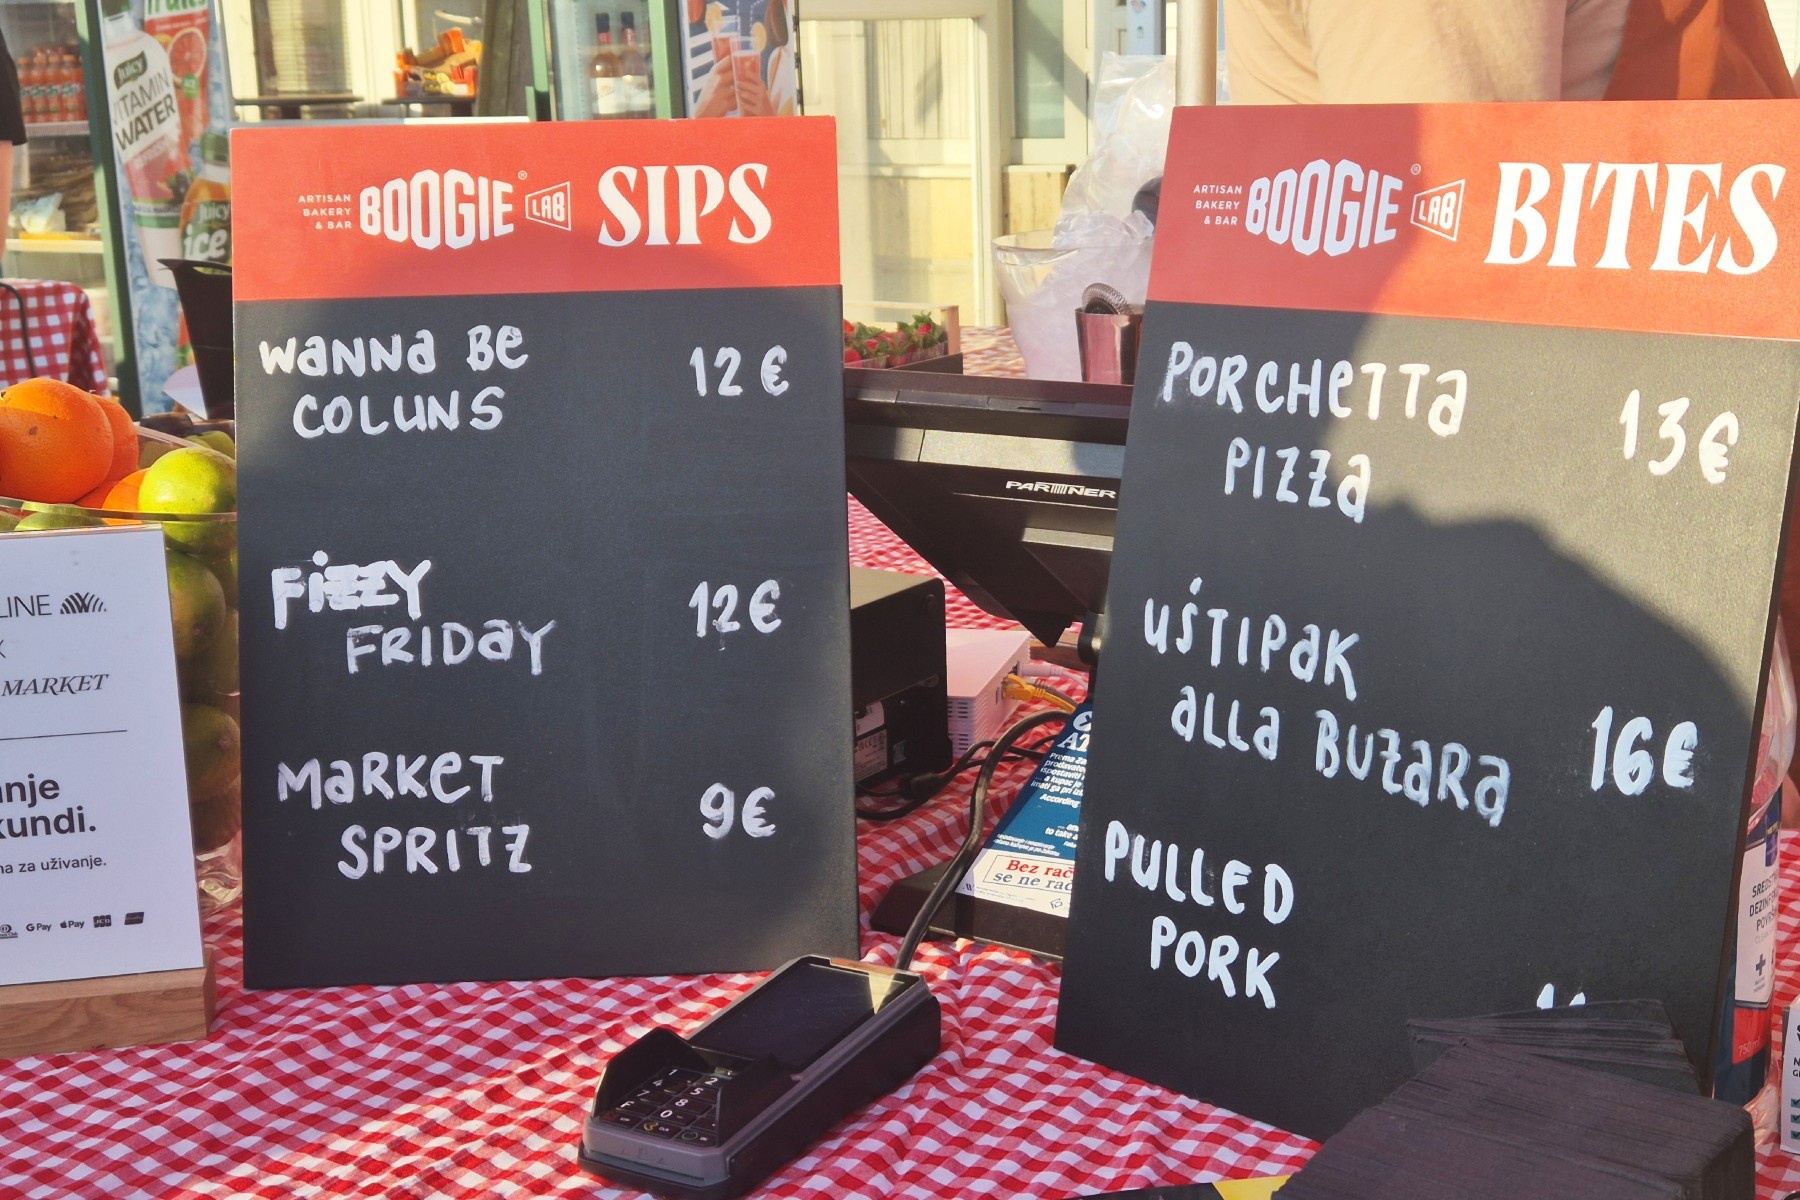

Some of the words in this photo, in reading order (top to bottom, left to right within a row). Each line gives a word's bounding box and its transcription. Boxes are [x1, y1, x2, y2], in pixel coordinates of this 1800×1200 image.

[115, 93, 176, 150] WATER
[1193, 184, 1243, 195] ARTISAN
[298, 194, 351, 203] ARTISAN
[597, 163, 772, 247] SIPS
[1195, 199, 1240, 210] BAKERY
[303, 207, 351, 217] BAKERY
[360, 169, 514, 250] BOOGIE
[532, 191, 566, 223] LAB
[1245, 159, 1403, 257] BOOGIE
[1418, 191, 1457, 230] LAB
[315, 221, 323, 230] &
[327, 221, 351, 229] BAR
[1203, 215, 1211, 225] &
[1208, 216, 1239, 225] BAR
[1483, 161, 1787, 276] BITES
[184, 223, 228, 261] ice
[1, 673, 110, 697] MARKET
[0, 773, 60, 808] nje
[1040, 793, 1081, 809] According
[337, 824, 532, 880] SPRITZ
[18, 862, 36, 873] za
[41, 855, 107, 871] uživanje.
[1006, 859, 1040, 875] Bez
[993, 872, 1013, 883] se
[1017, 876, 1041, 887] ne
[37, 923, 52, 932] Pay
[68, 920, 84, 929] Pay
[1151, 915, 1280, 1009] PORK
[704, 1077, 718, 1086] 2
[690, 1087, 704, 1095] 5
[675, 1098, 689, 1107] 8
